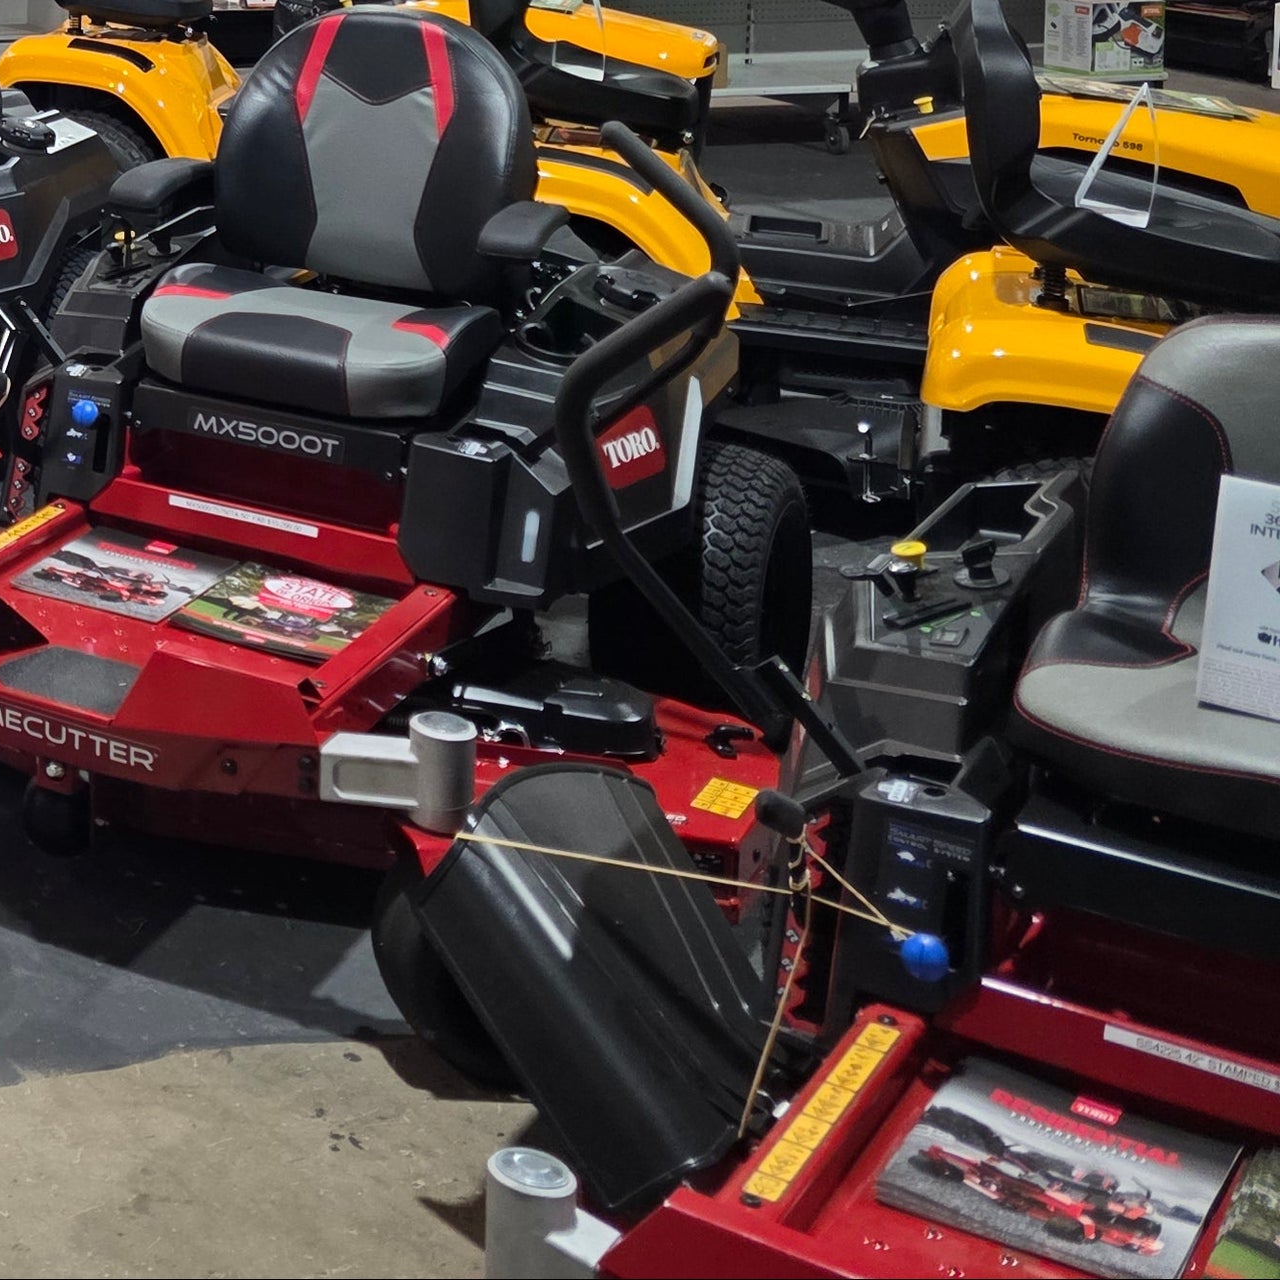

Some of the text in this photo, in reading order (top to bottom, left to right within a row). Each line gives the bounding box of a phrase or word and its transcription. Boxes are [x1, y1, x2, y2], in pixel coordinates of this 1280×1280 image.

[1122, 140, 1143, 152] 598
[194, 412, 340, 458] MX5000T
[602, 423, 657, 470] TORO
[283, 581, 339, 605] STATE
